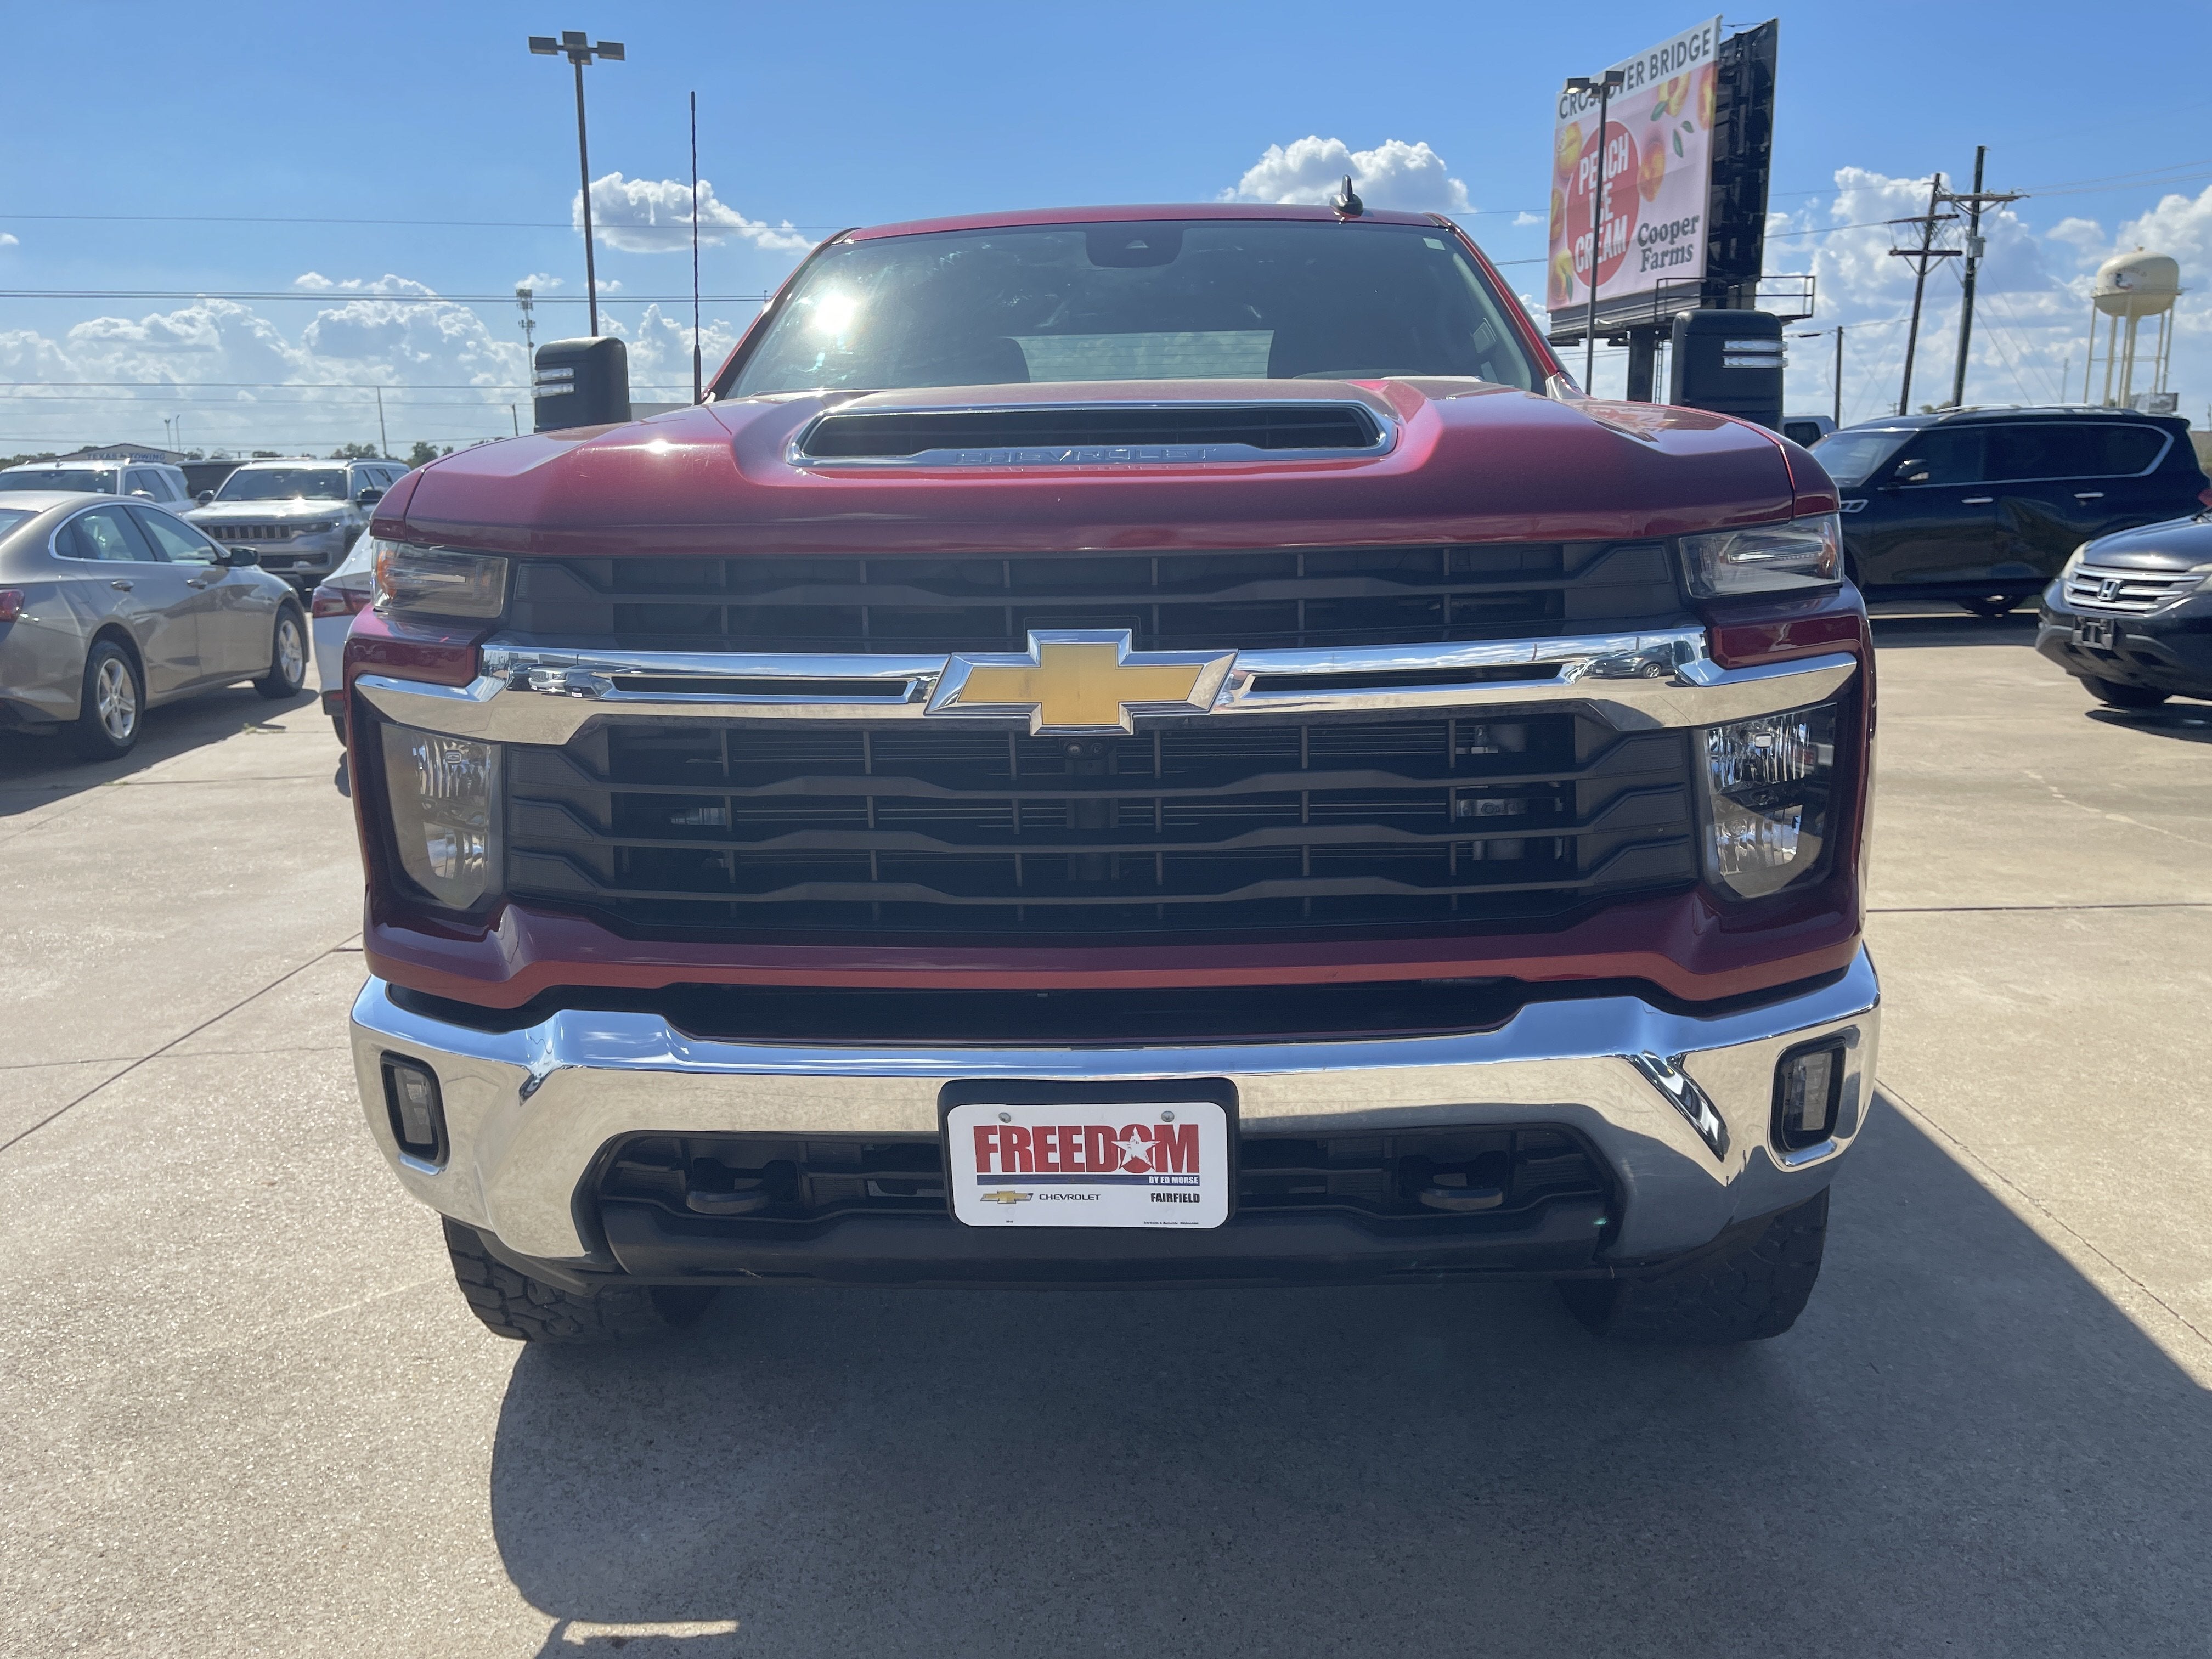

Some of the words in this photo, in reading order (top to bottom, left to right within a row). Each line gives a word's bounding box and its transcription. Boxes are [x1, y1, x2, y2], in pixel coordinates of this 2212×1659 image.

[1559, 60, 1644, 119] CROER
[1649, 27, 1711, 81] BRIDGE
[1589, 182, 1613, 229] IE
[1638, 214, 1700, 247] Cooper
[1640, 244, 1694, 273] Farms
[956, 448, 1216, 464] CHEVROLET
[973, 1124, 1200, 1173] FREEDOM
[1148, 1176, 1159, 1184] BY
[1171, 1176, 1199, 1184] MORSE
[1150, 1193, 1200, 1203] FAIRFIELD
